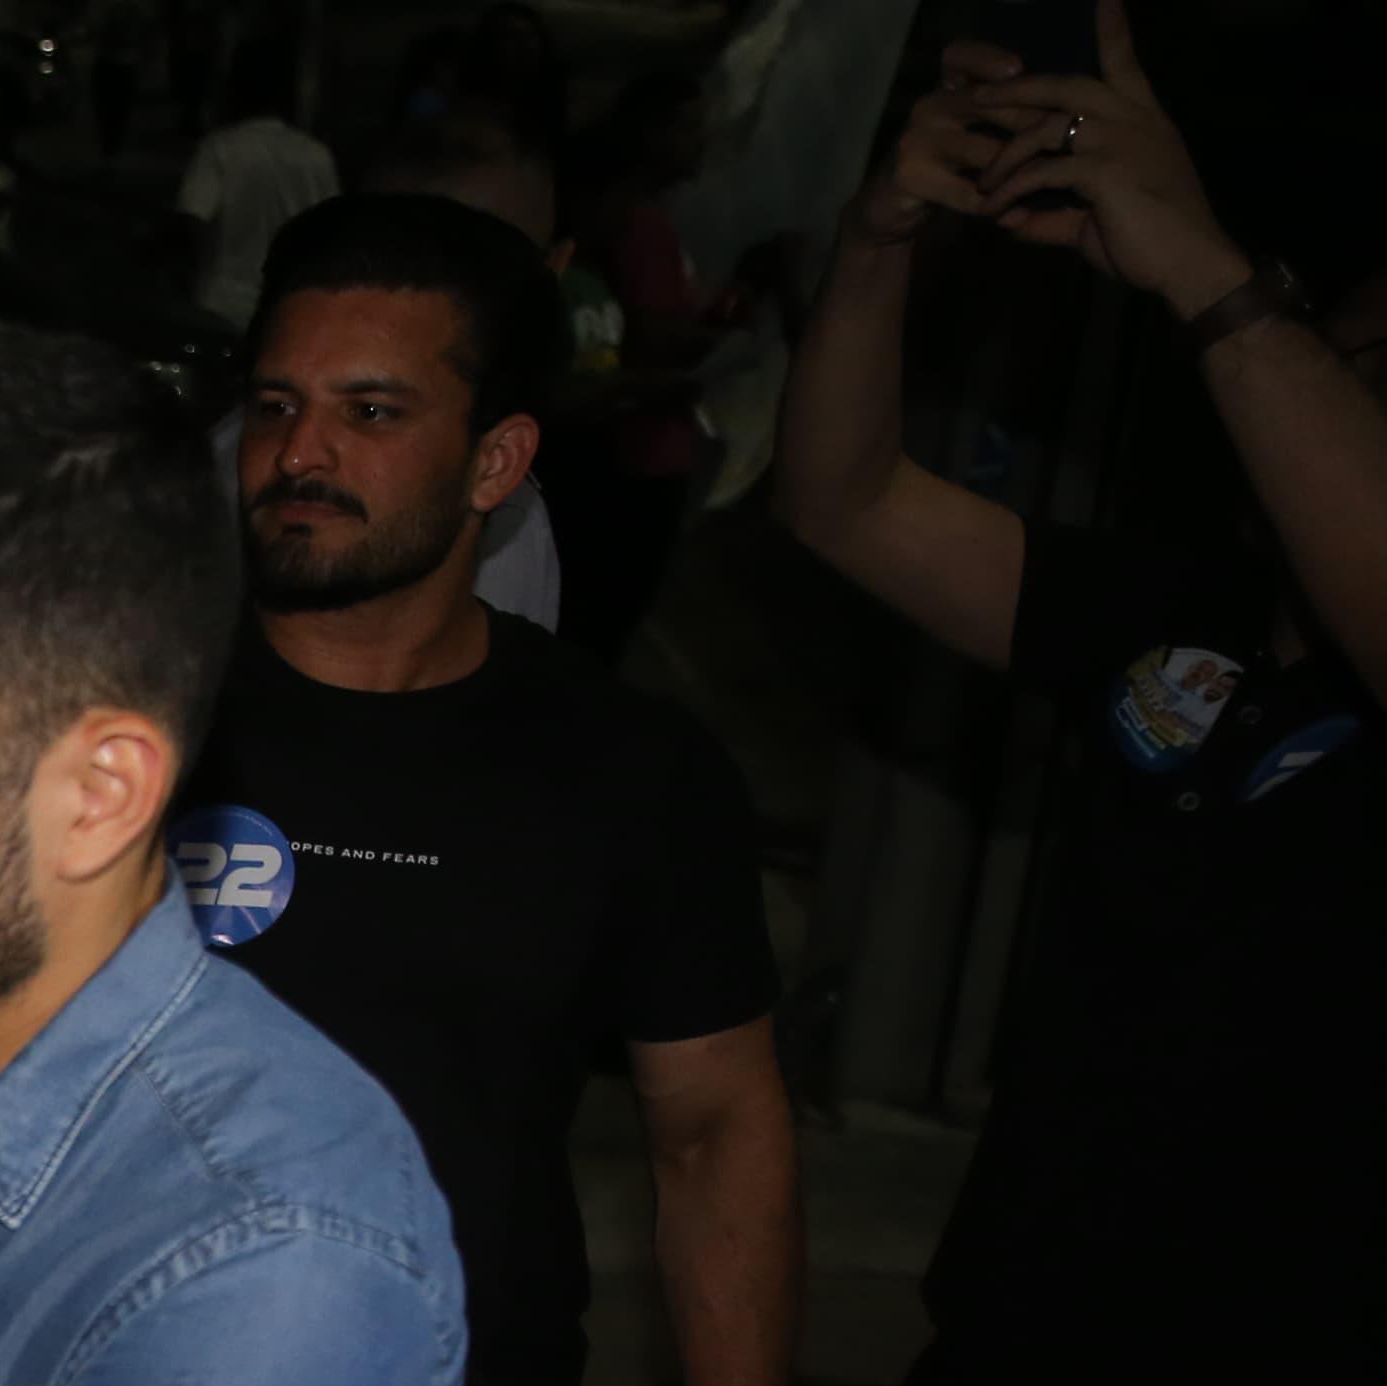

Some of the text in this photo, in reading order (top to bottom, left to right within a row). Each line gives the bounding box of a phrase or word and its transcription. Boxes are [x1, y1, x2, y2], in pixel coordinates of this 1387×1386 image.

[177, 842, 282, 908] 22
[287, 841, 440, 866] OPES AND FEARS
